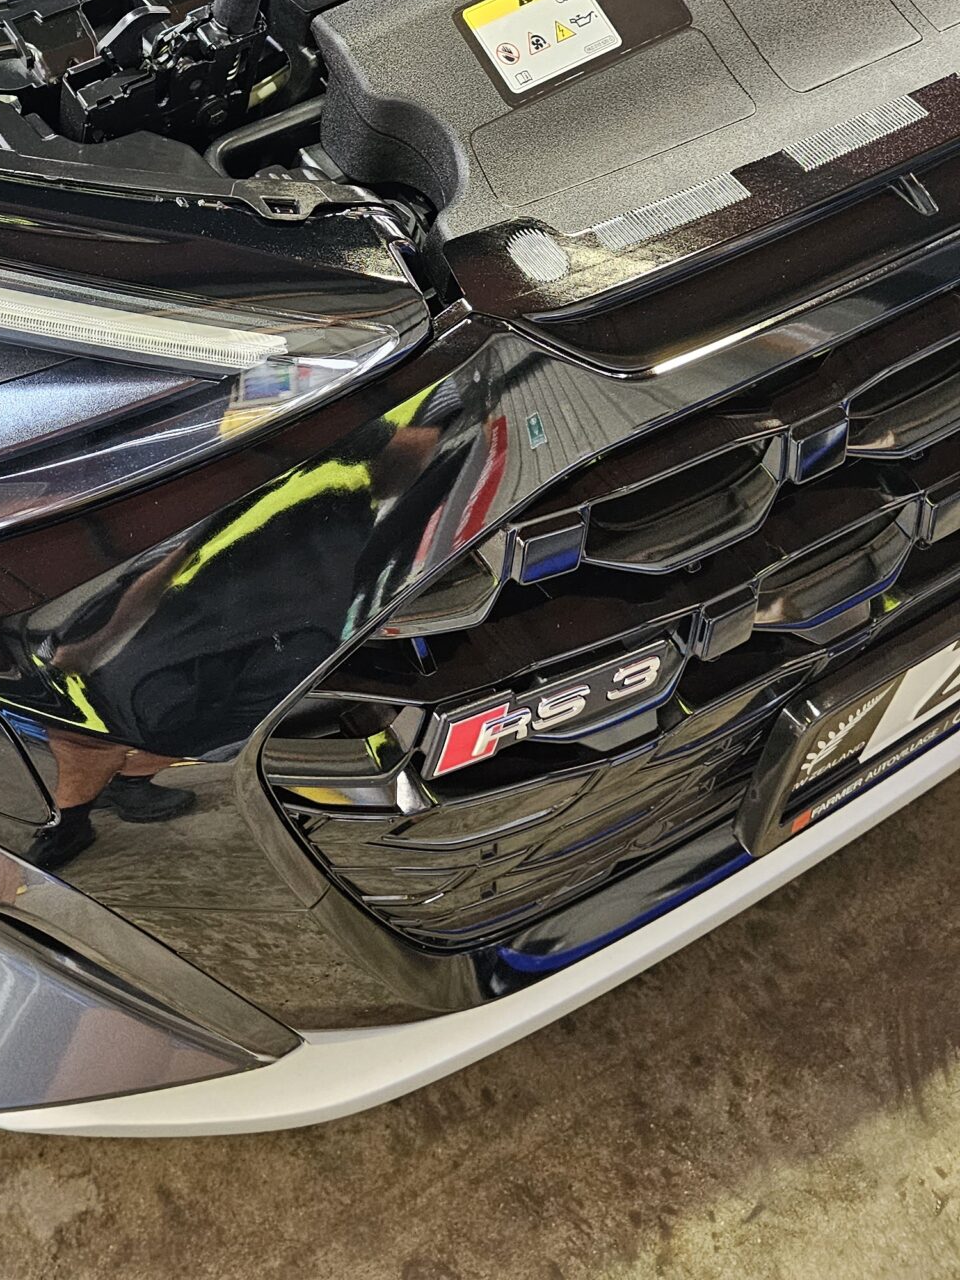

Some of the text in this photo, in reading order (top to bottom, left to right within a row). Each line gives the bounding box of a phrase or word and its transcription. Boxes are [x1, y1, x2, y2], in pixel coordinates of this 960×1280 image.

[470, 655, 661, 757] RS 3
[810, 777, 864, 819] FARMER
[864, 727, 940, 783] AUTOVILLAGE
